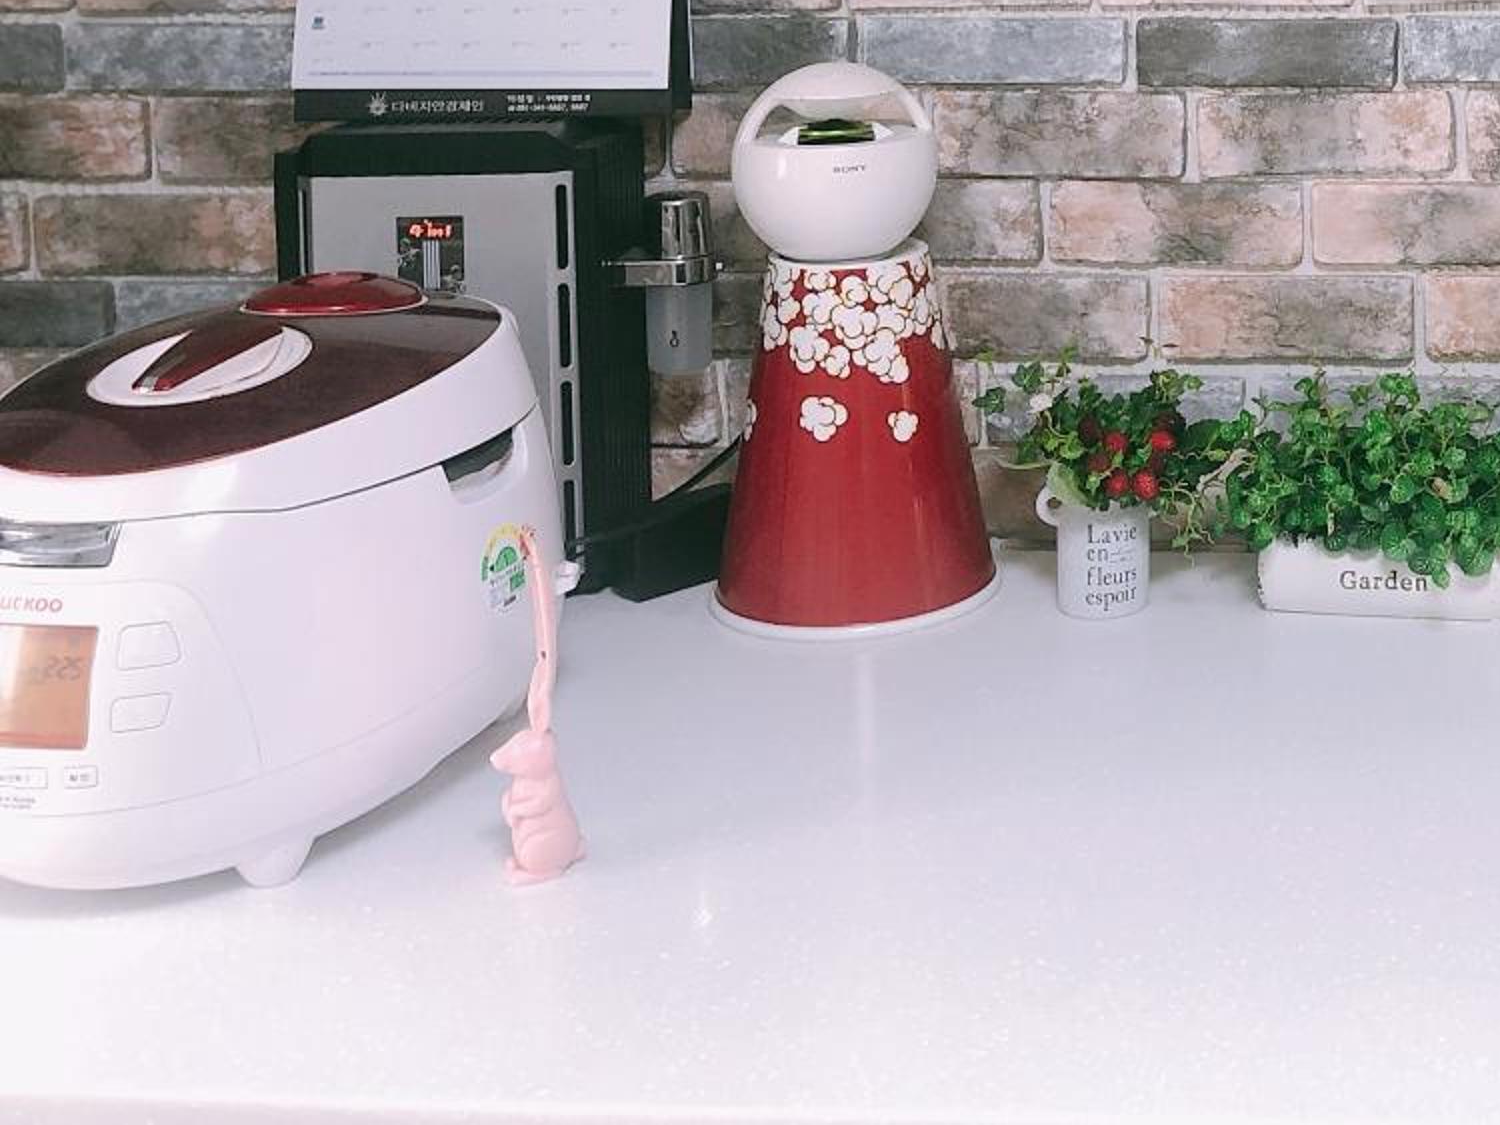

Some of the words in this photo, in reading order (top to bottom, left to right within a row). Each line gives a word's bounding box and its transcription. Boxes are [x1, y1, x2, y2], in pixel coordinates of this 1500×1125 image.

[1087, 548, 1108, 562] en
[1087, 566, 1137, 586] fleurs
[1340, 570, 1427, 591] Garden
[0, 596, 63, 613] UCKOO
[1085, 584, 1137, 612] espoir
